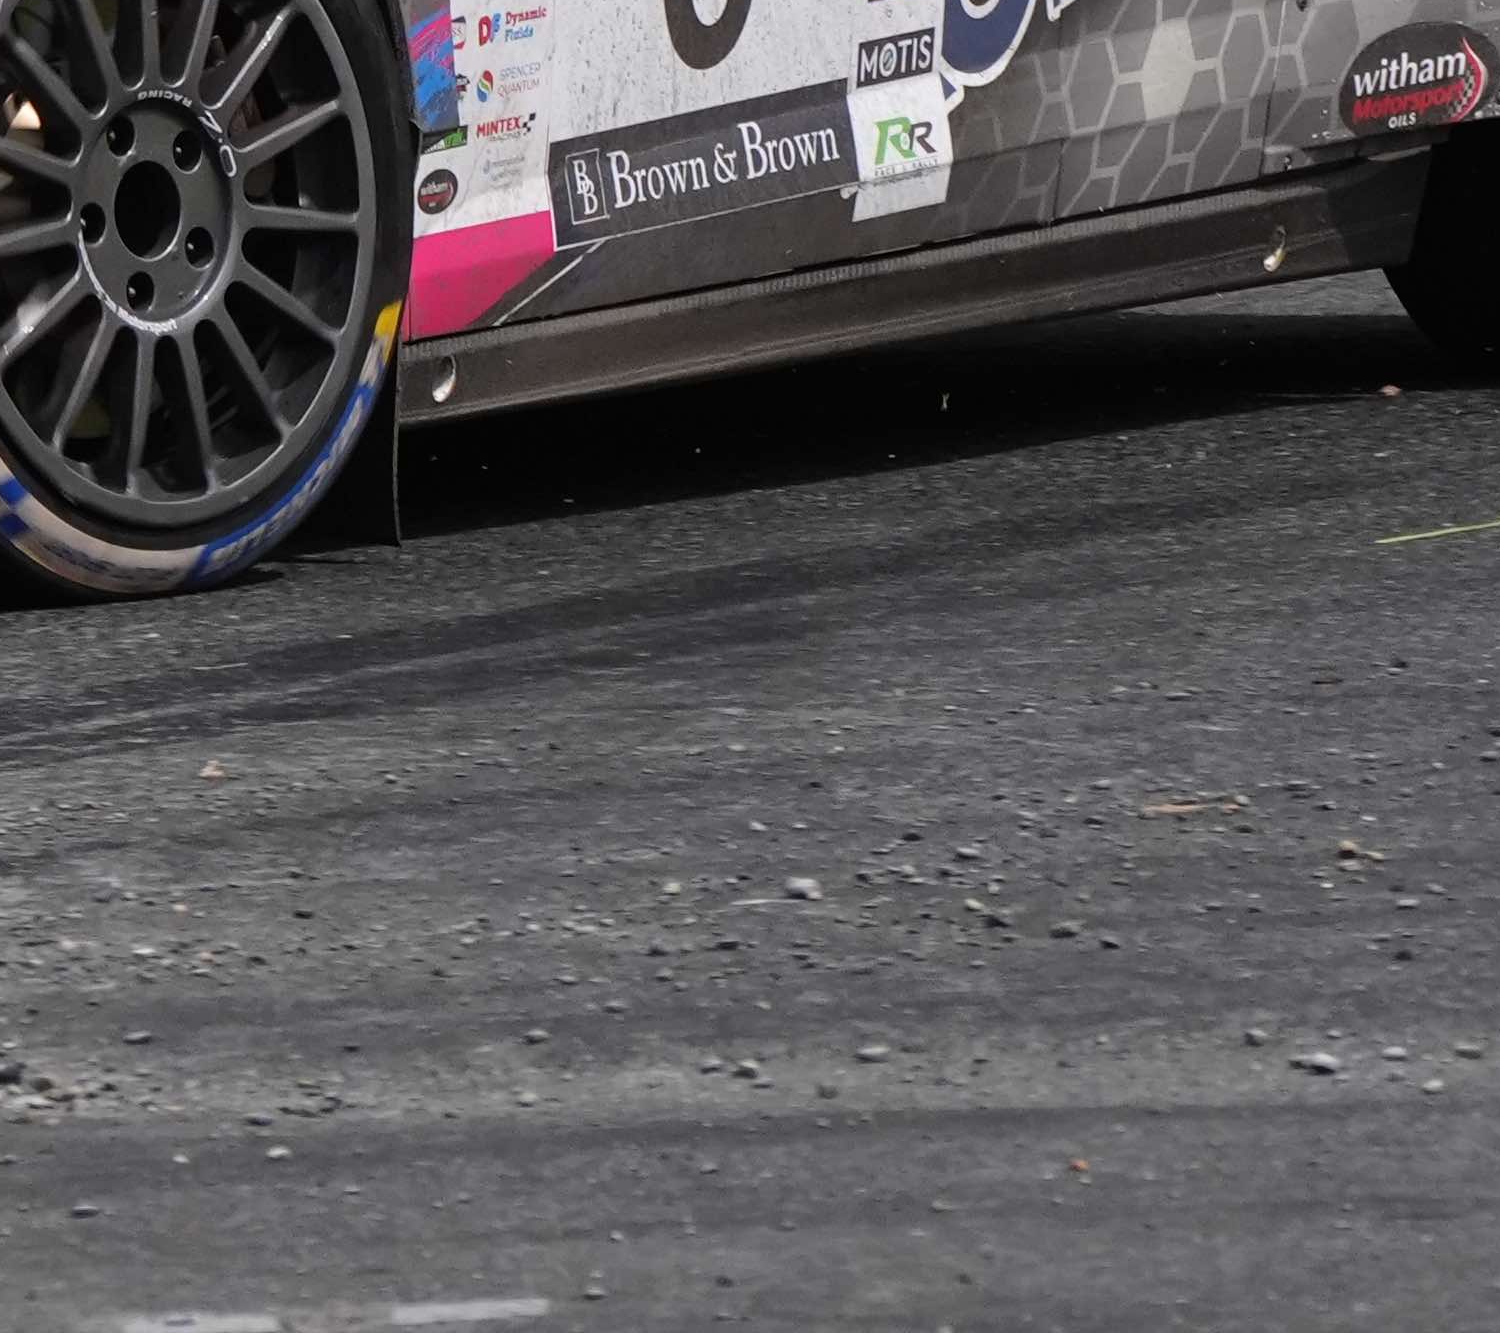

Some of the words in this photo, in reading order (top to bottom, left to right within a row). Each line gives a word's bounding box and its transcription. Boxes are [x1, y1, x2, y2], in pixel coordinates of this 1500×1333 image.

[505, 5, 548, 27] Dynamic
[504, 25, 534, 43] Fluids
[860, 33, 933, 83] MOTIS
[1353, 51, 1467, 98] witham
[137, 89, 194, 108] RACING
[476, 116, 521, 139] MINTEX
[1388, 111, 1416, 129] OILS
[606, 149, 711, 209] Brown
[712, 143, 738, 184] &
[737, 120, 841, 181] Brown
